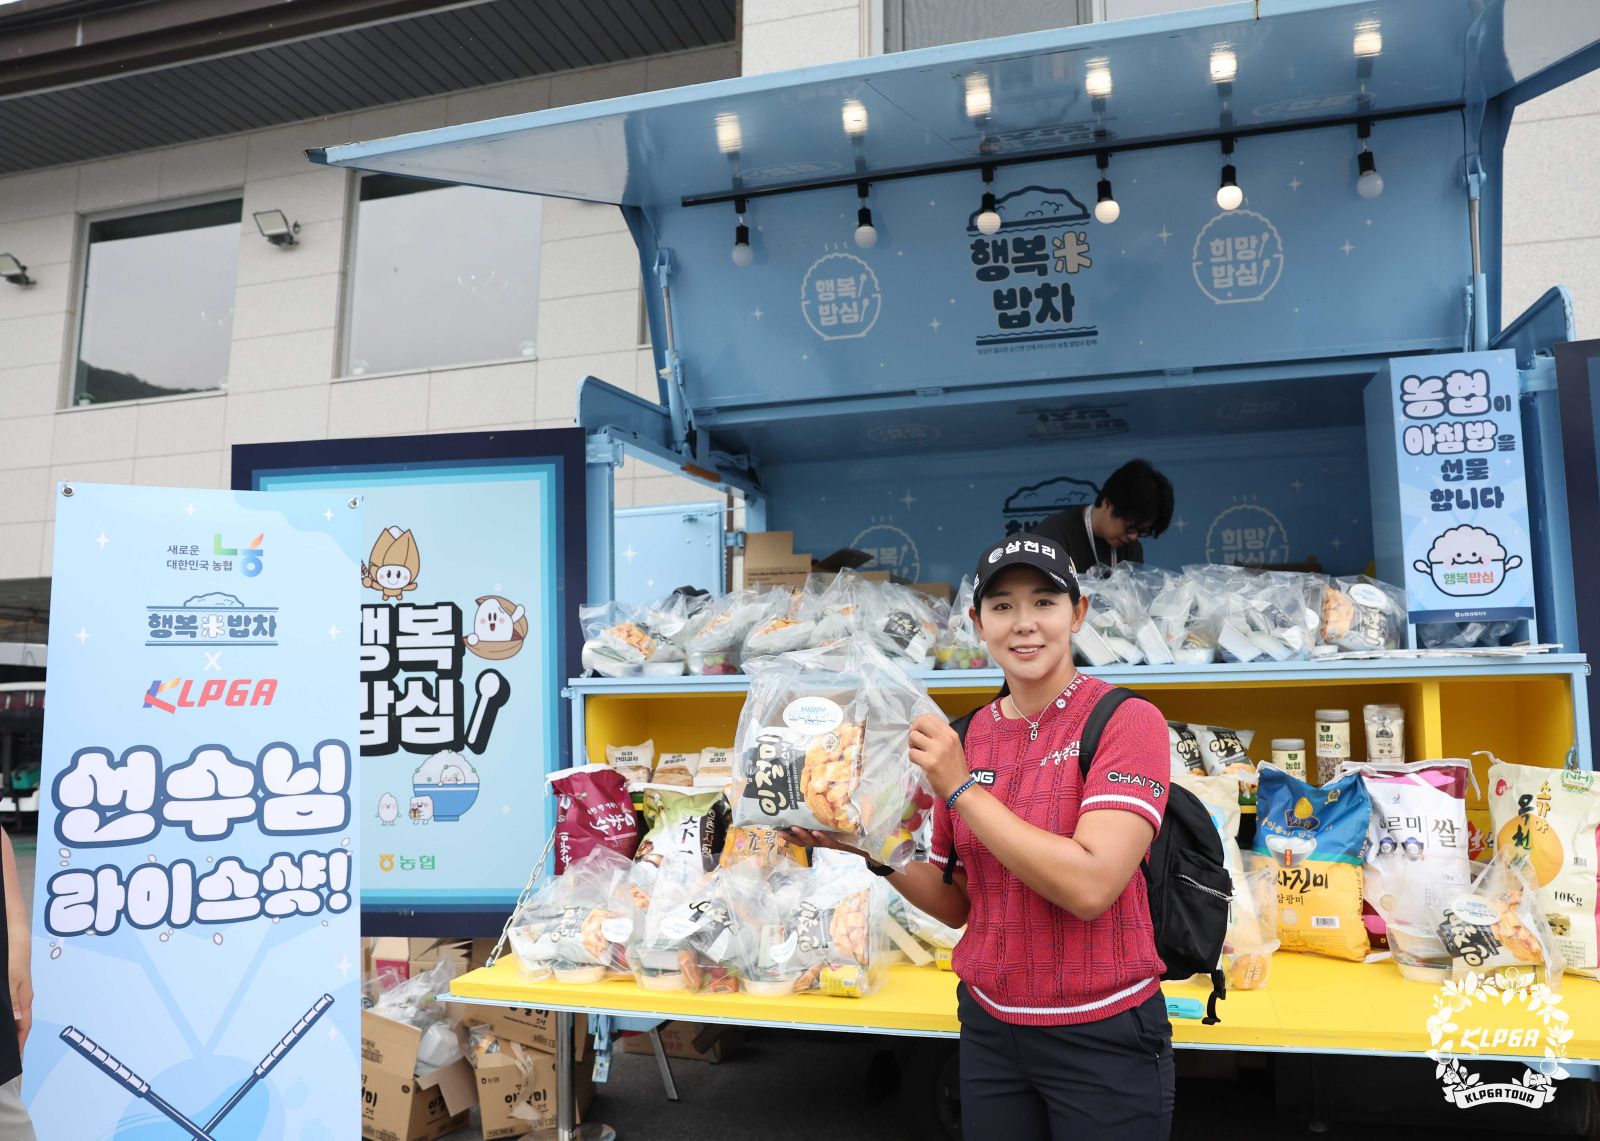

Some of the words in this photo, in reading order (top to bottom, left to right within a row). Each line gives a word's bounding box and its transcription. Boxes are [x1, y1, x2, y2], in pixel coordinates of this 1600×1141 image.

[1209, 234, 1259, 261] 희망
[815, 275, 857, 301] 행복
[1212, 262, 1259, 289] 밥심
[818, 299, 860, 326] 밥심
[993, 282, 1076, 329] 밥차
[1441, 458, 1490, 482] 선물
[1430, 486, 1505, 512] 합니다
[167, 544, 200, 556] 새로운
[1005, 540, 1056, 560] 삼천리
[1222, 528, 1266, 550] 희망
[167, 559, 210, 571] 대한민국
[212, 560, 233, 572] 농협
[1443, 571, 1495, 585] 행복밥심
[142, 677, 279, 714] KLPGA
[755, 734, 789, 816] 인절미
[1565, 772, 1589, 783] NH
[51, 739, 352, 849] 선수님
[1432, 818, 1461, 848] 쌀
[399, 855, 437, 871] 농협
[43, 847, 353, 938] 라이스샷!
[1553, 890, 1583, 907] 10Kg
